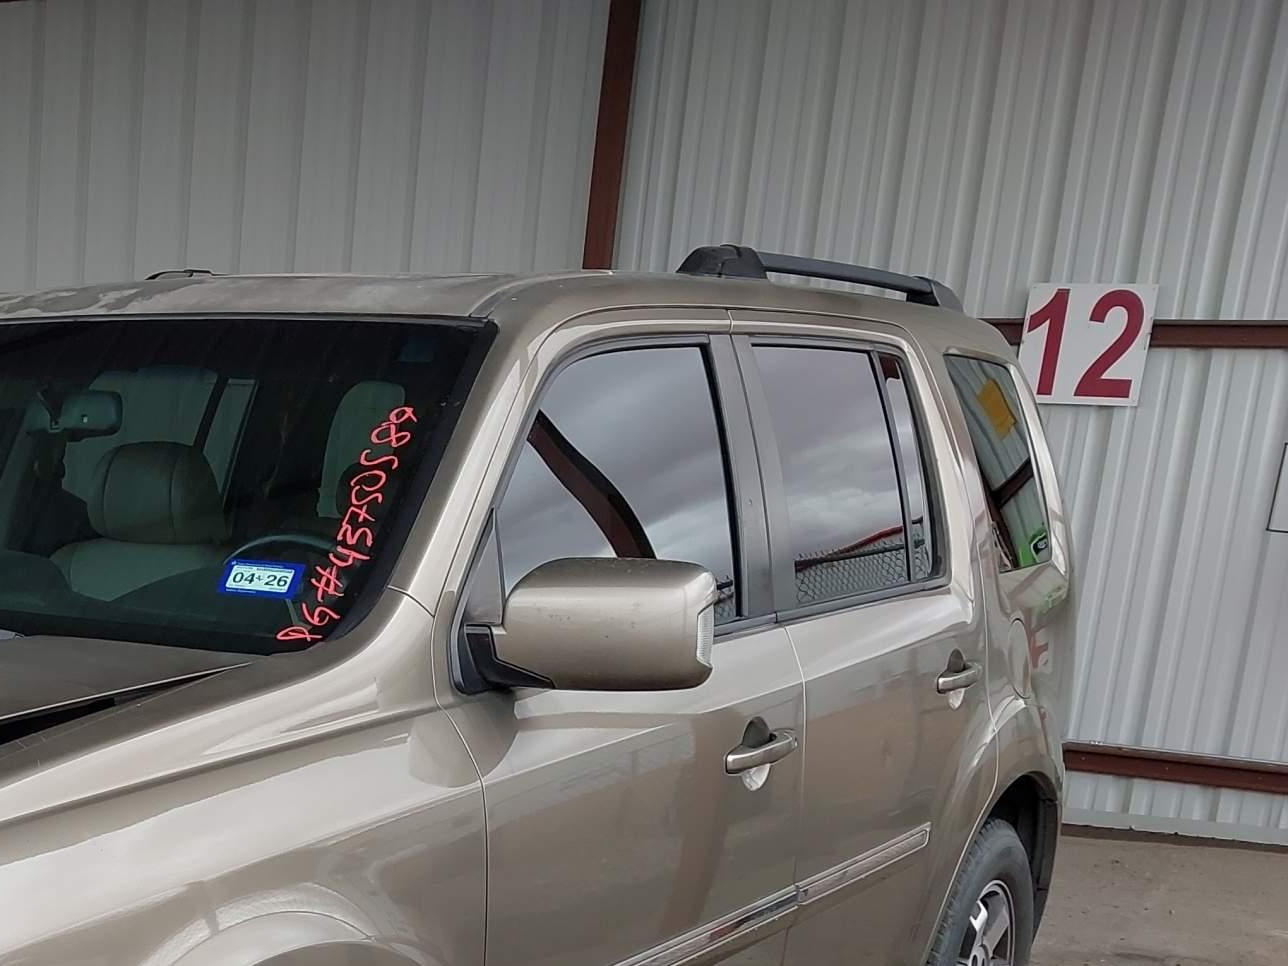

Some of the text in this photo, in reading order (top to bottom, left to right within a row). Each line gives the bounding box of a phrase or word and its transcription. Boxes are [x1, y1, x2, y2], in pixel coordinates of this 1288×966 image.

[1027, 288, 1145, 399] 12
[232, 572, 290, 587] 04 26
